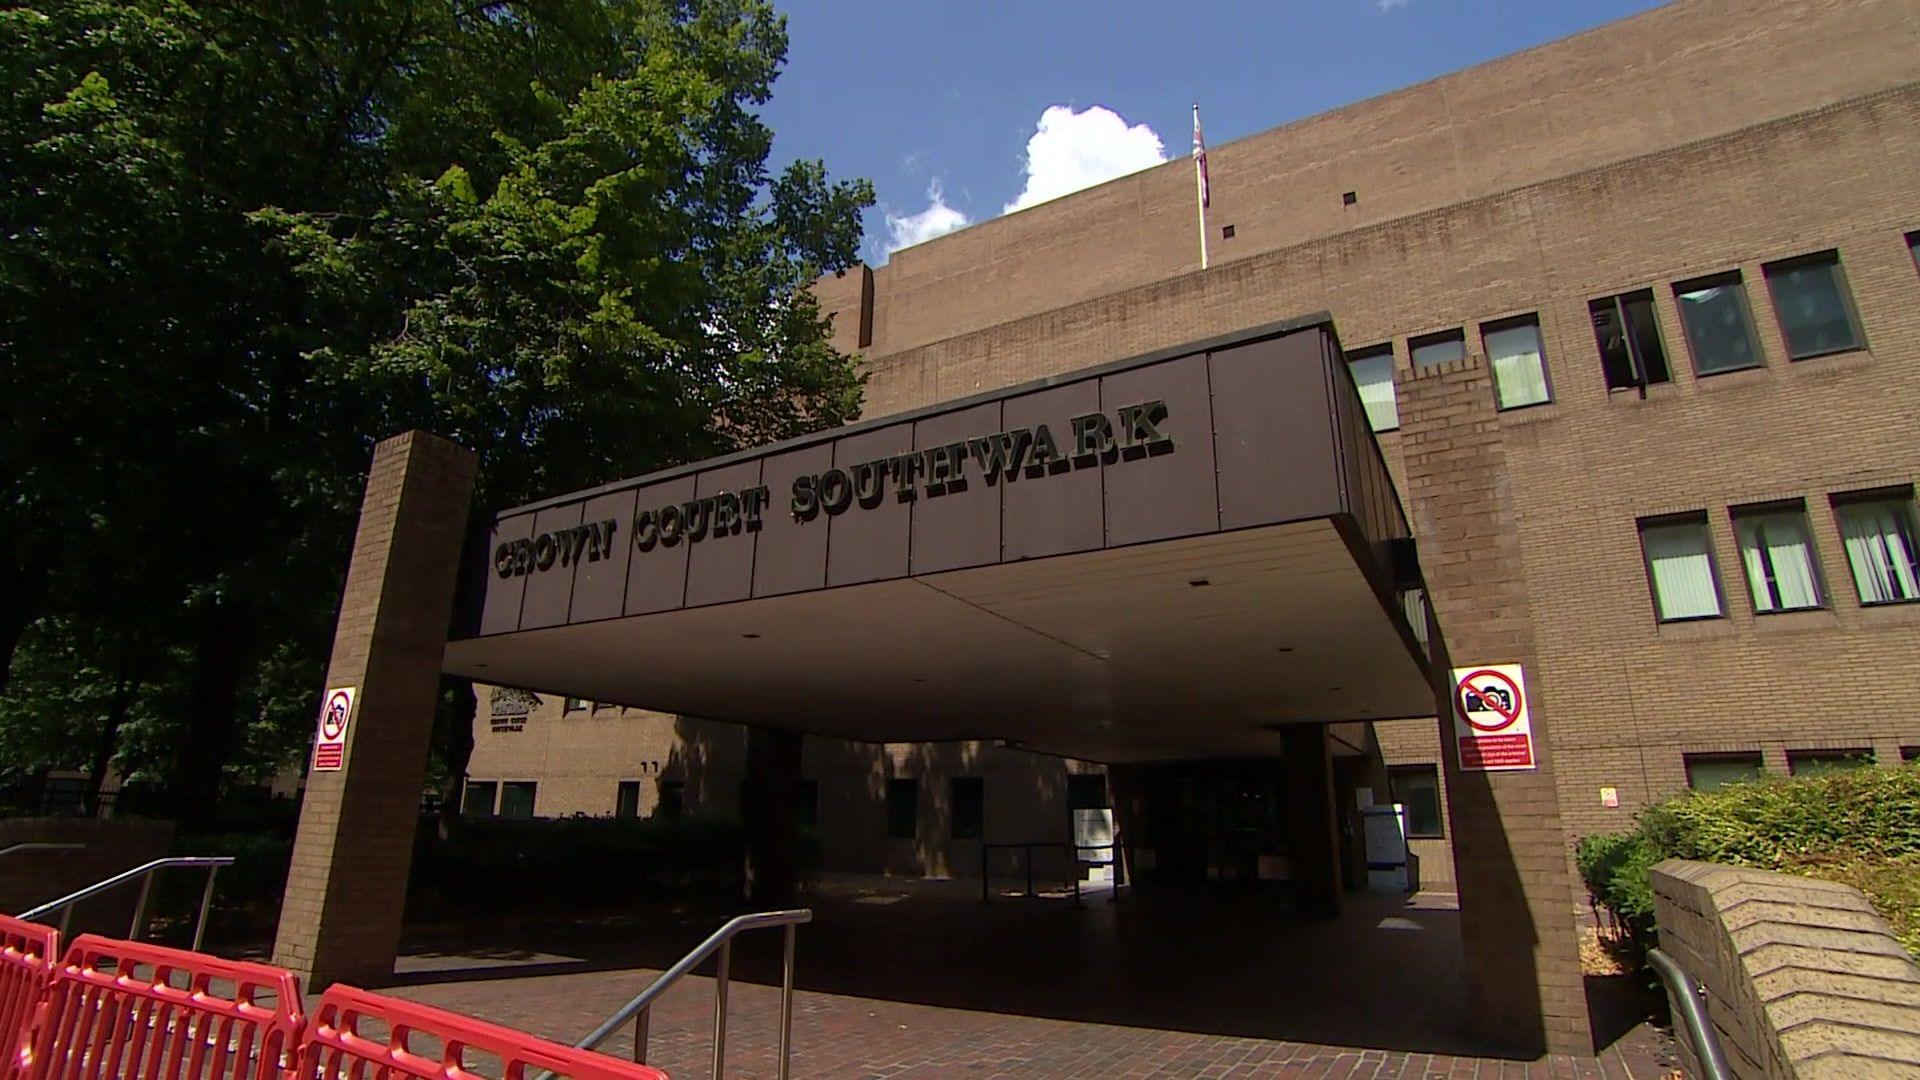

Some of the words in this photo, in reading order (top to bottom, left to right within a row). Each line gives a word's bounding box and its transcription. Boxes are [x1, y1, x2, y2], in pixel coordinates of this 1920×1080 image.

[495, 519, 616, 579] CROWN
[635, 485, 769, 552] COURT
[791, 400, 1174, 521] SOUTHWARK
